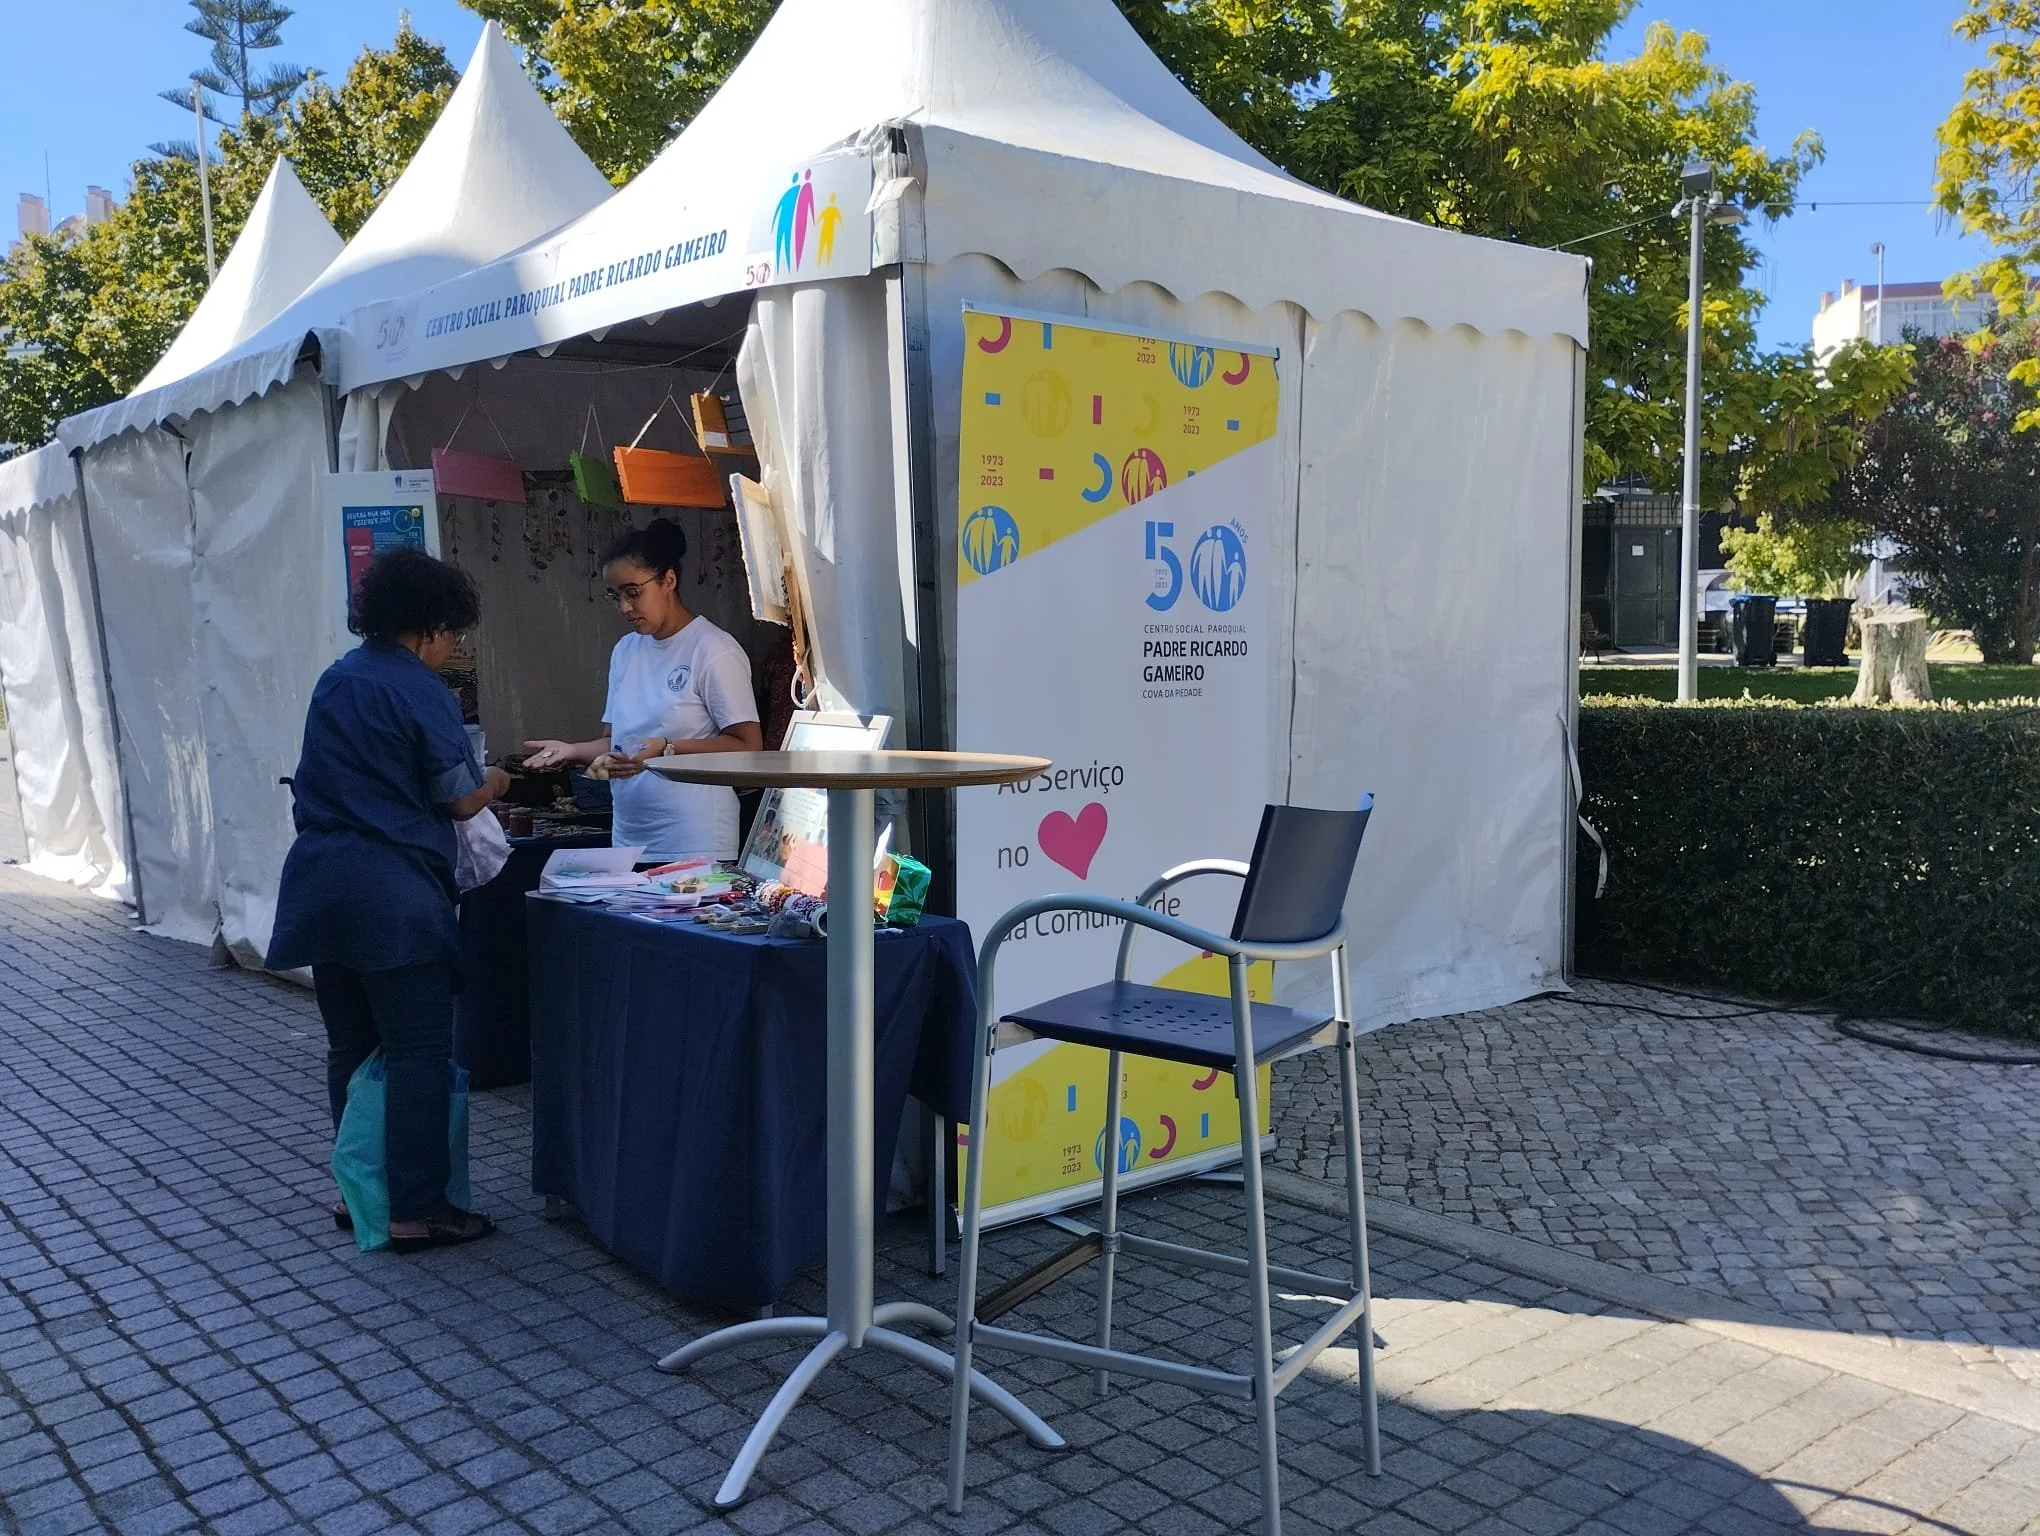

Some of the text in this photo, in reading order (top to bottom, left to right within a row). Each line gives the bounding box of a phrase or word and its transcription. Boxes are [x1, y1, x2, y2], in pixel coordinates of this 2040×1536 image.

[426, 229, 728, 339] CENTRO SOCIAL PAROQUIAL PADRE RICARDO GAMEIRO
[1136, 352, 1156, 364] 2023
[1183, 405, 1200, 417] 1973
[1183, 424, 1200, 435] 2023
[981, 454, 1003, 466] 1973
[980, 475, 1003, 486] 2023
[1230, 517, 1249, 544] ANOS
[1144, 624, 1247, 634] CENTRO SOCIAL PAROQUIAL
[1143, 640, 1248, 658] PADRE RICARDO
[1143, 664, 1205, 682] GAMEIRO
[1142, 688, 1203, 699] COVA DA PIEDADE
[1038, 759, 1124, 794] Serviço
[998, 845, 1029, 869] no
[1062, 1144, 1081, 1157] 1973
[1062, 1161, 1081, 1175] 2023
